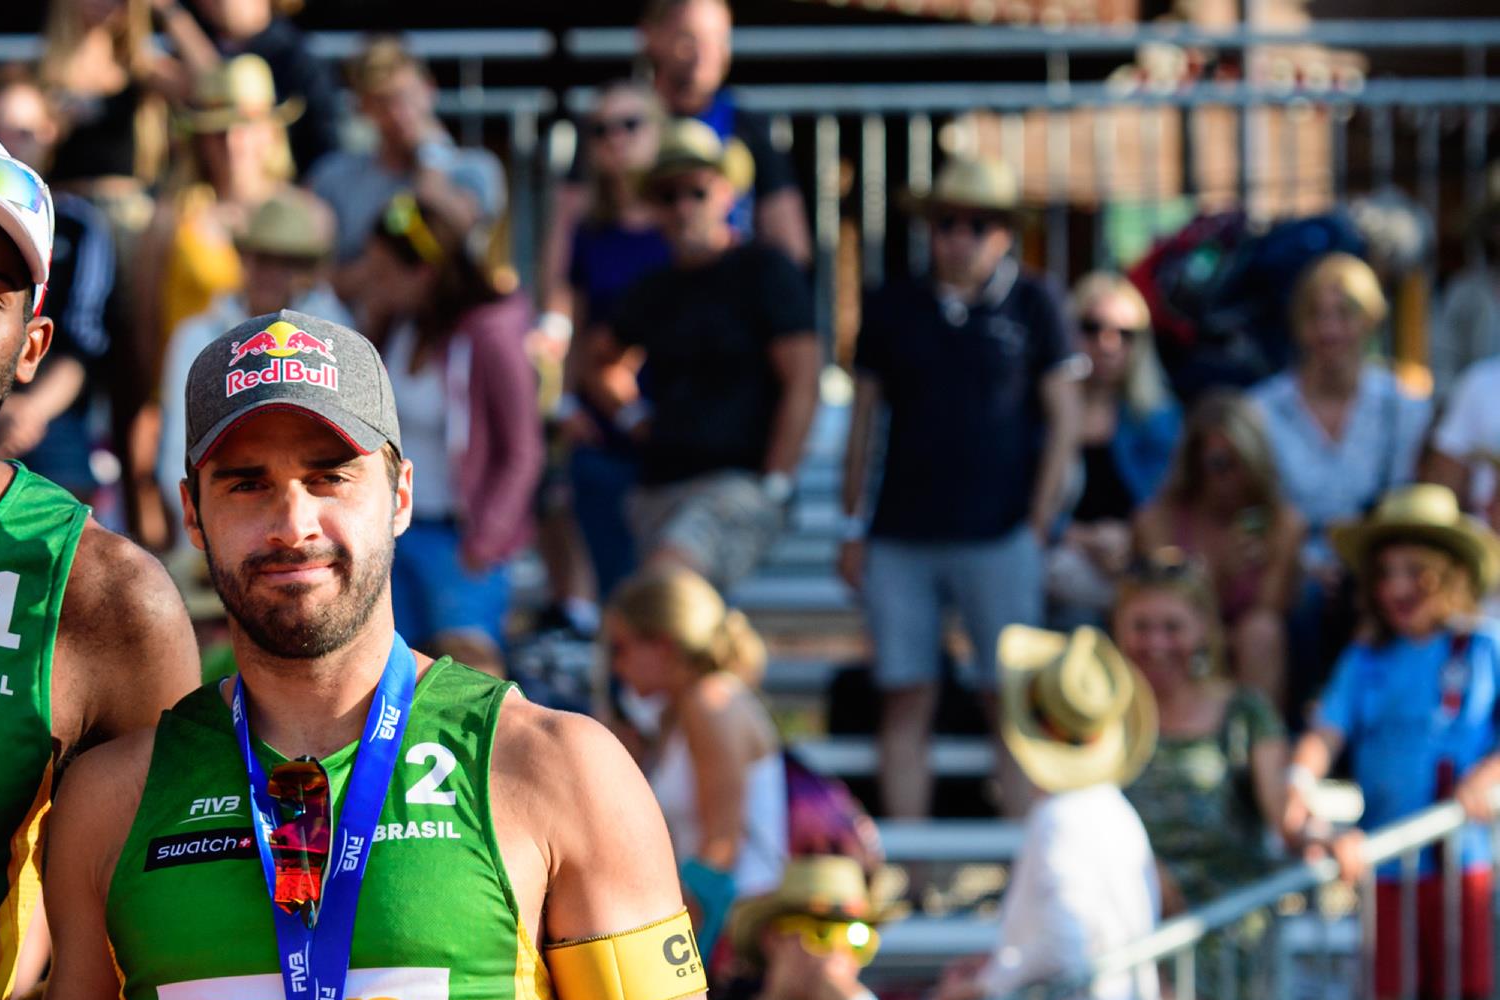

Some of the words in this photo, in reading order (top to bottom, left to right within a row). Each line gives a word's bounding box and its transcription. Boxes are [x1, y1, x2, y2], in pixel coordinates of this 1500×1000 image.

[226, 358, 279, 398] Red
[283, 358, 339, 392] Bull
[379, 704, 401, 741] FIVB
[405, 741, 457, 806] 2
[189, 795, 241, 815] FIVB
[157, 836, 238, 860] swatch
[372, 821, 462, 842] BRASIL
[342, 835, 364, 872] FIVB
[288, 951, 308, 993] FIVB
